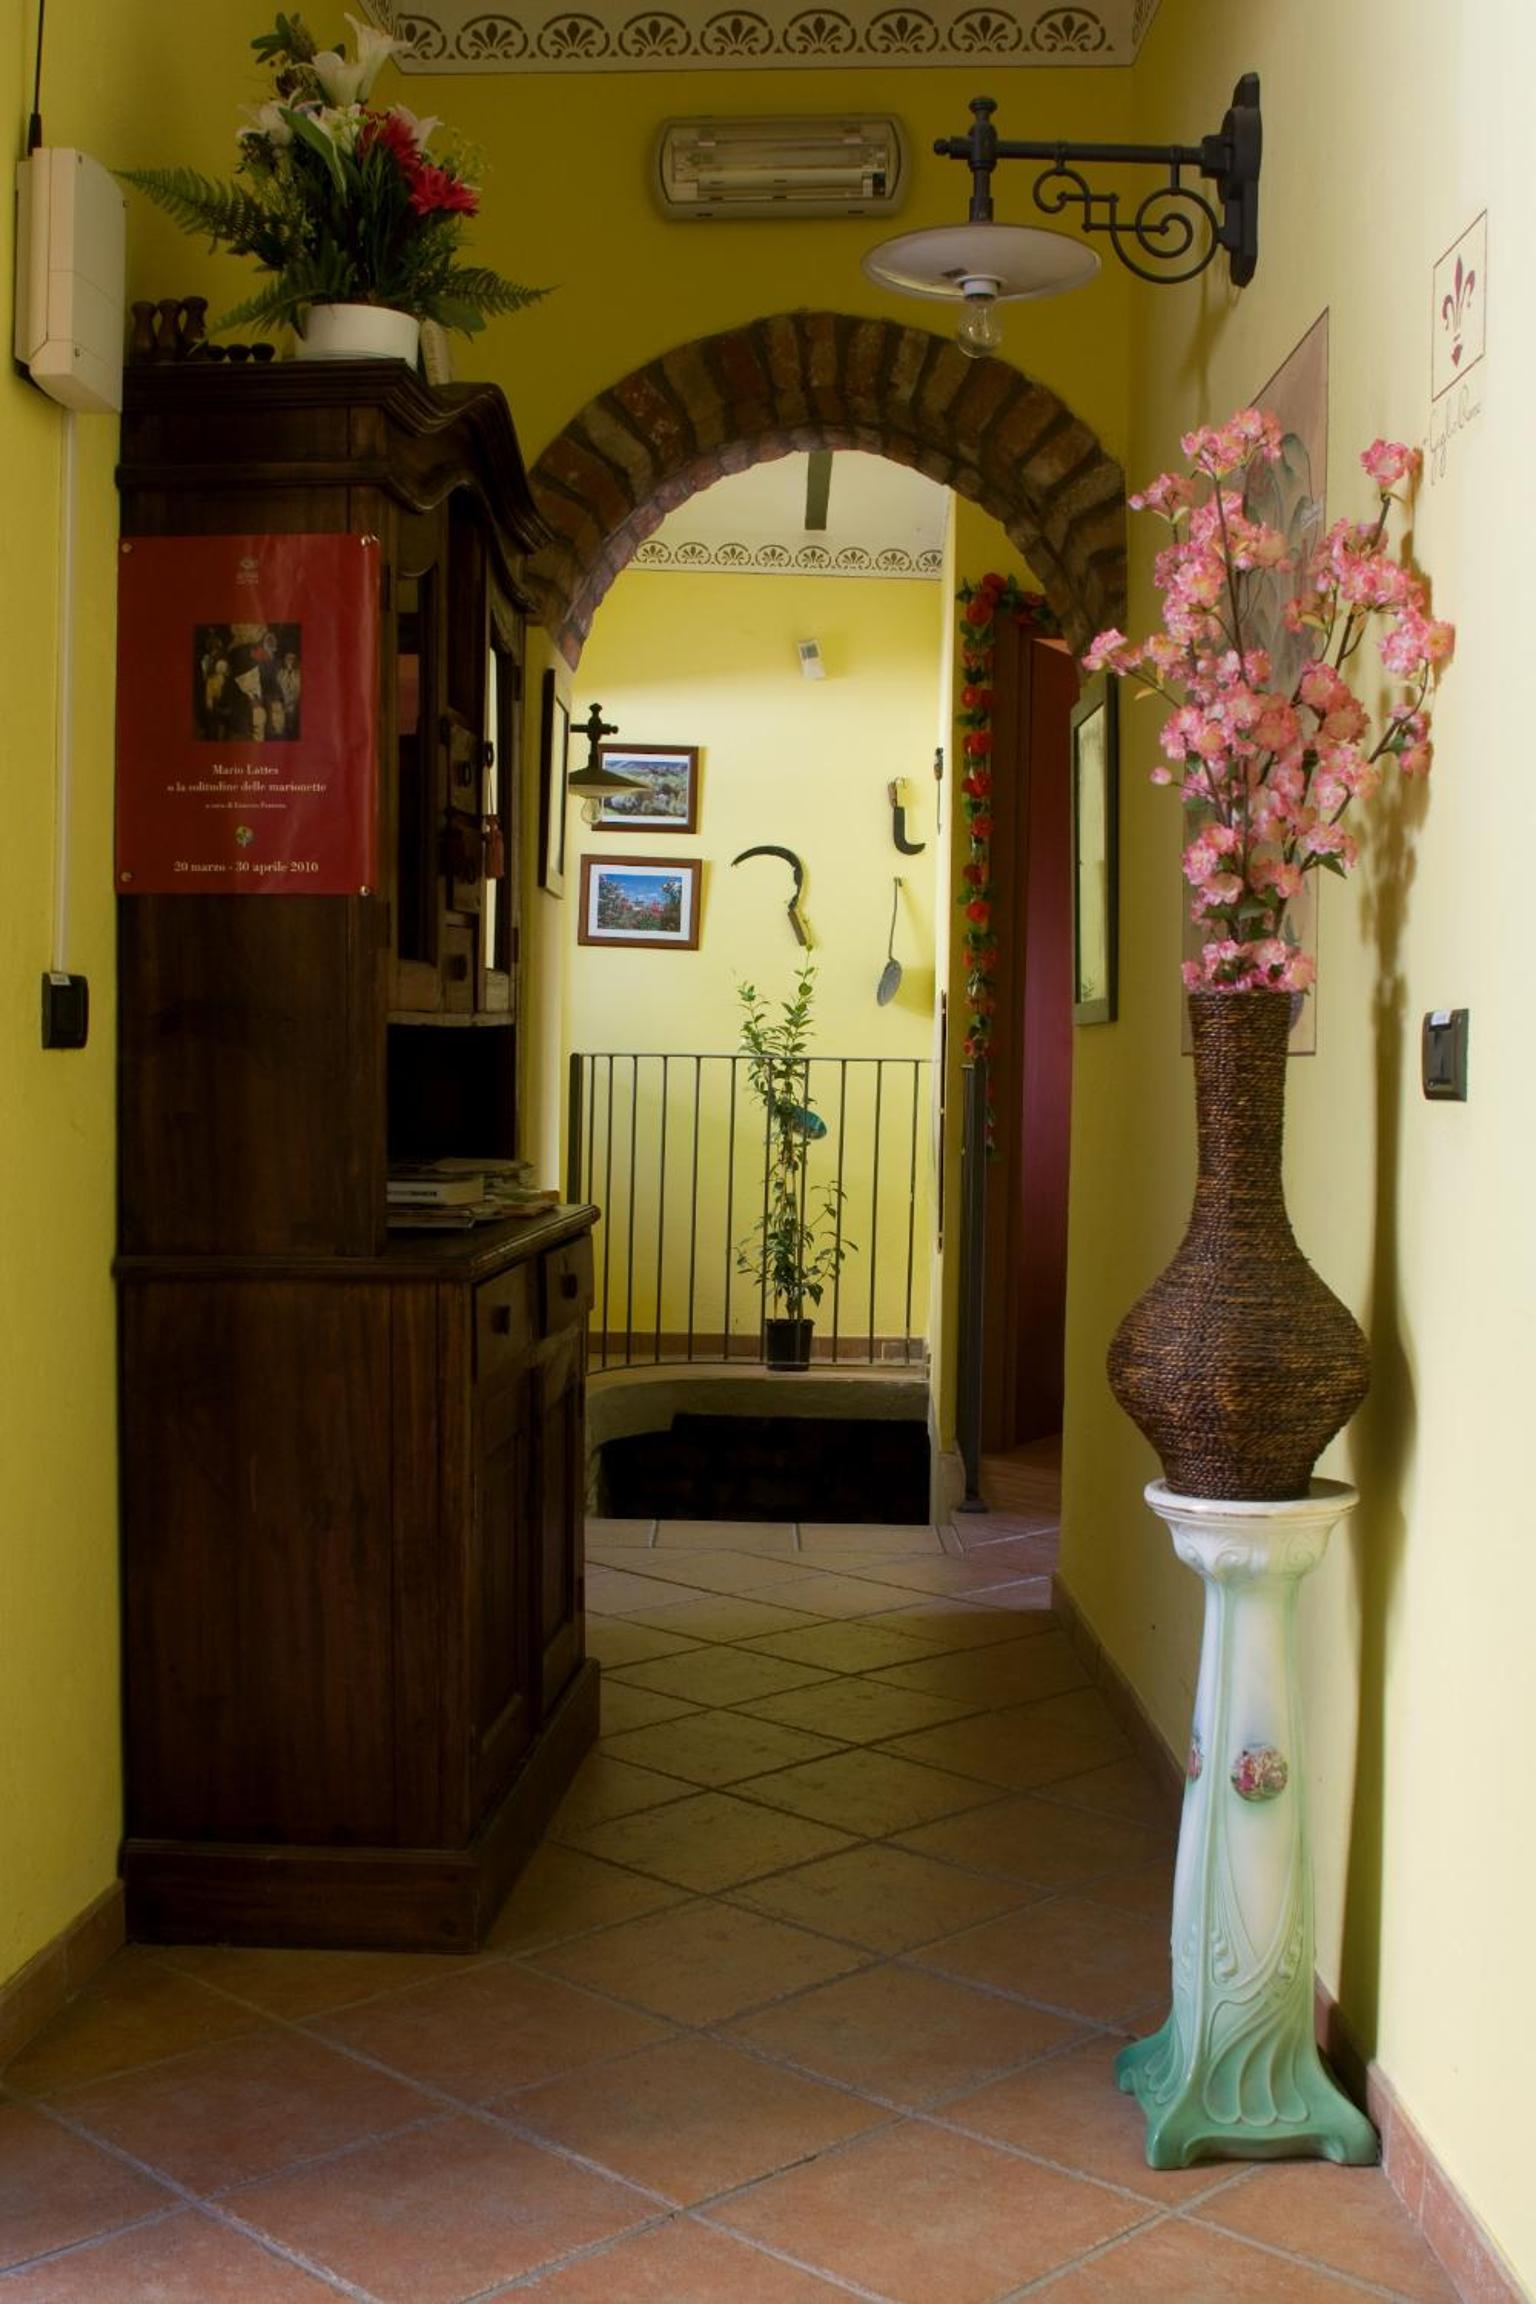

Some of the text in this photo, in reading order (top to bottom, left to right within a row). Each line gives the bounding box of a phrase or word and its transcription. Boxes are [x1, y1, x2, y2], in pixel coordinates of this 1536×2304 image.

[212, 764, 279, 775] Mario Lattes
[176, 781, 186, 792] la
[240, 781, 266, 792] delle
[173, 861, 188, 872] 20
[191, 863, 226, 872] marzo
[235, 861, 250, 872] 30
[252, 861, 288, 875] aprile
[289, 861, 319, 872] 2010
